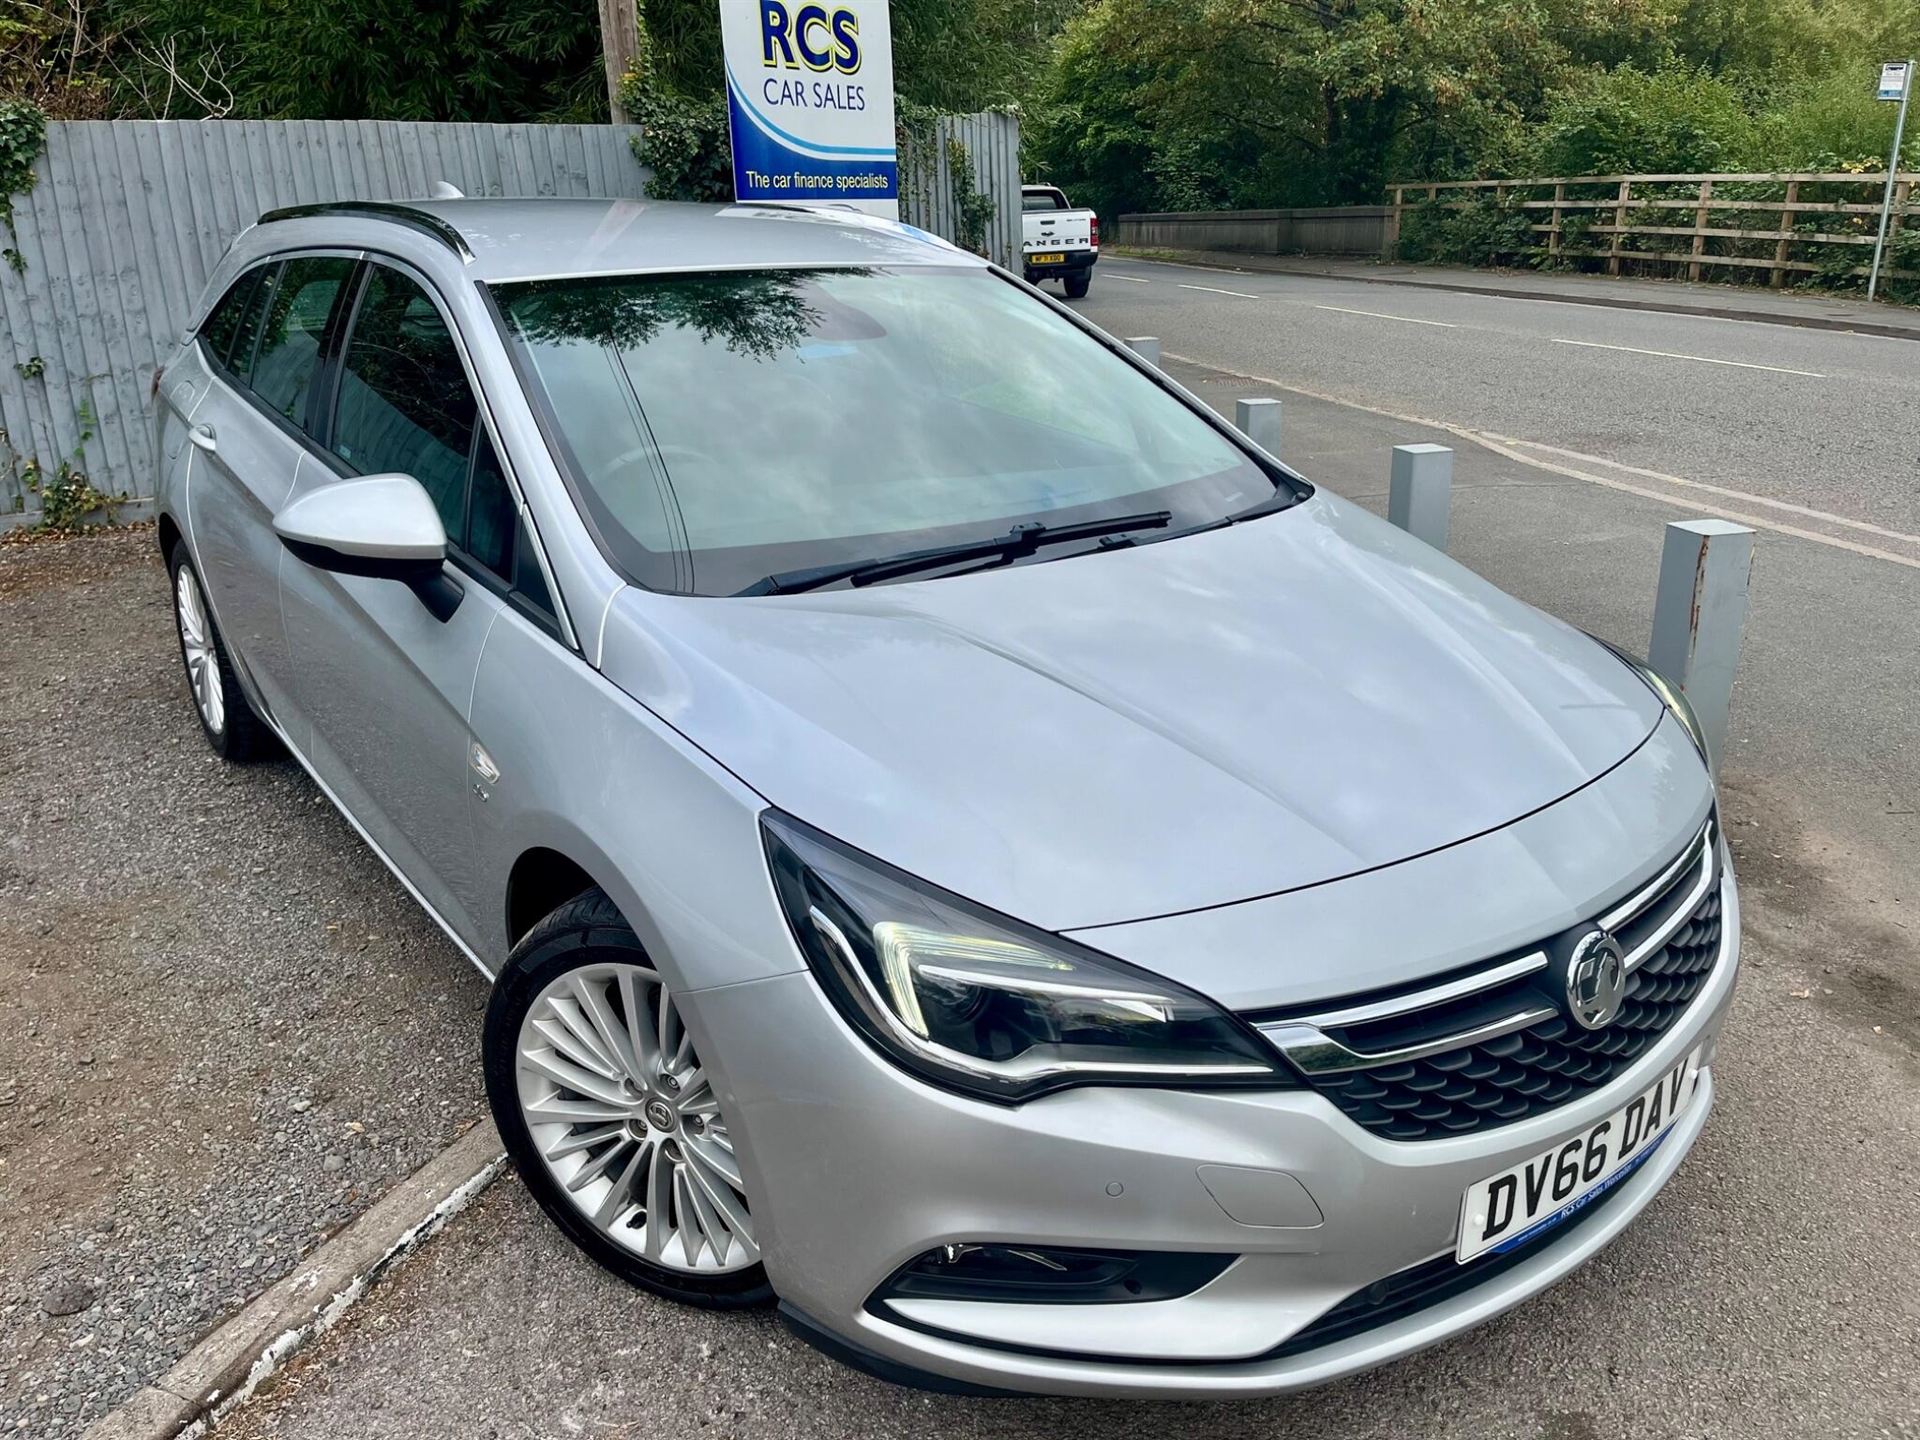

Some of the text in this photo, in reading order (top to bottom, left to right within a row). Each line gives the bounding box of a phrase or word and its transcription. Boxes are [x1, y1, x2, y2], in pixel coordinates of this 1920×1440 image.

[759, 0, 862, 75] RCS
[763, 78, 865, 111] CAR SALES
[746, 171, 888, 192] The car finance specialists
[1023, 238, 1089, 247] ANGER
[1482, 1057, 1689, 1242] DV66 DAV
[1560, 1203, 1576, 1219] RCS
[1576, 1196, 1588, 1208] Car
